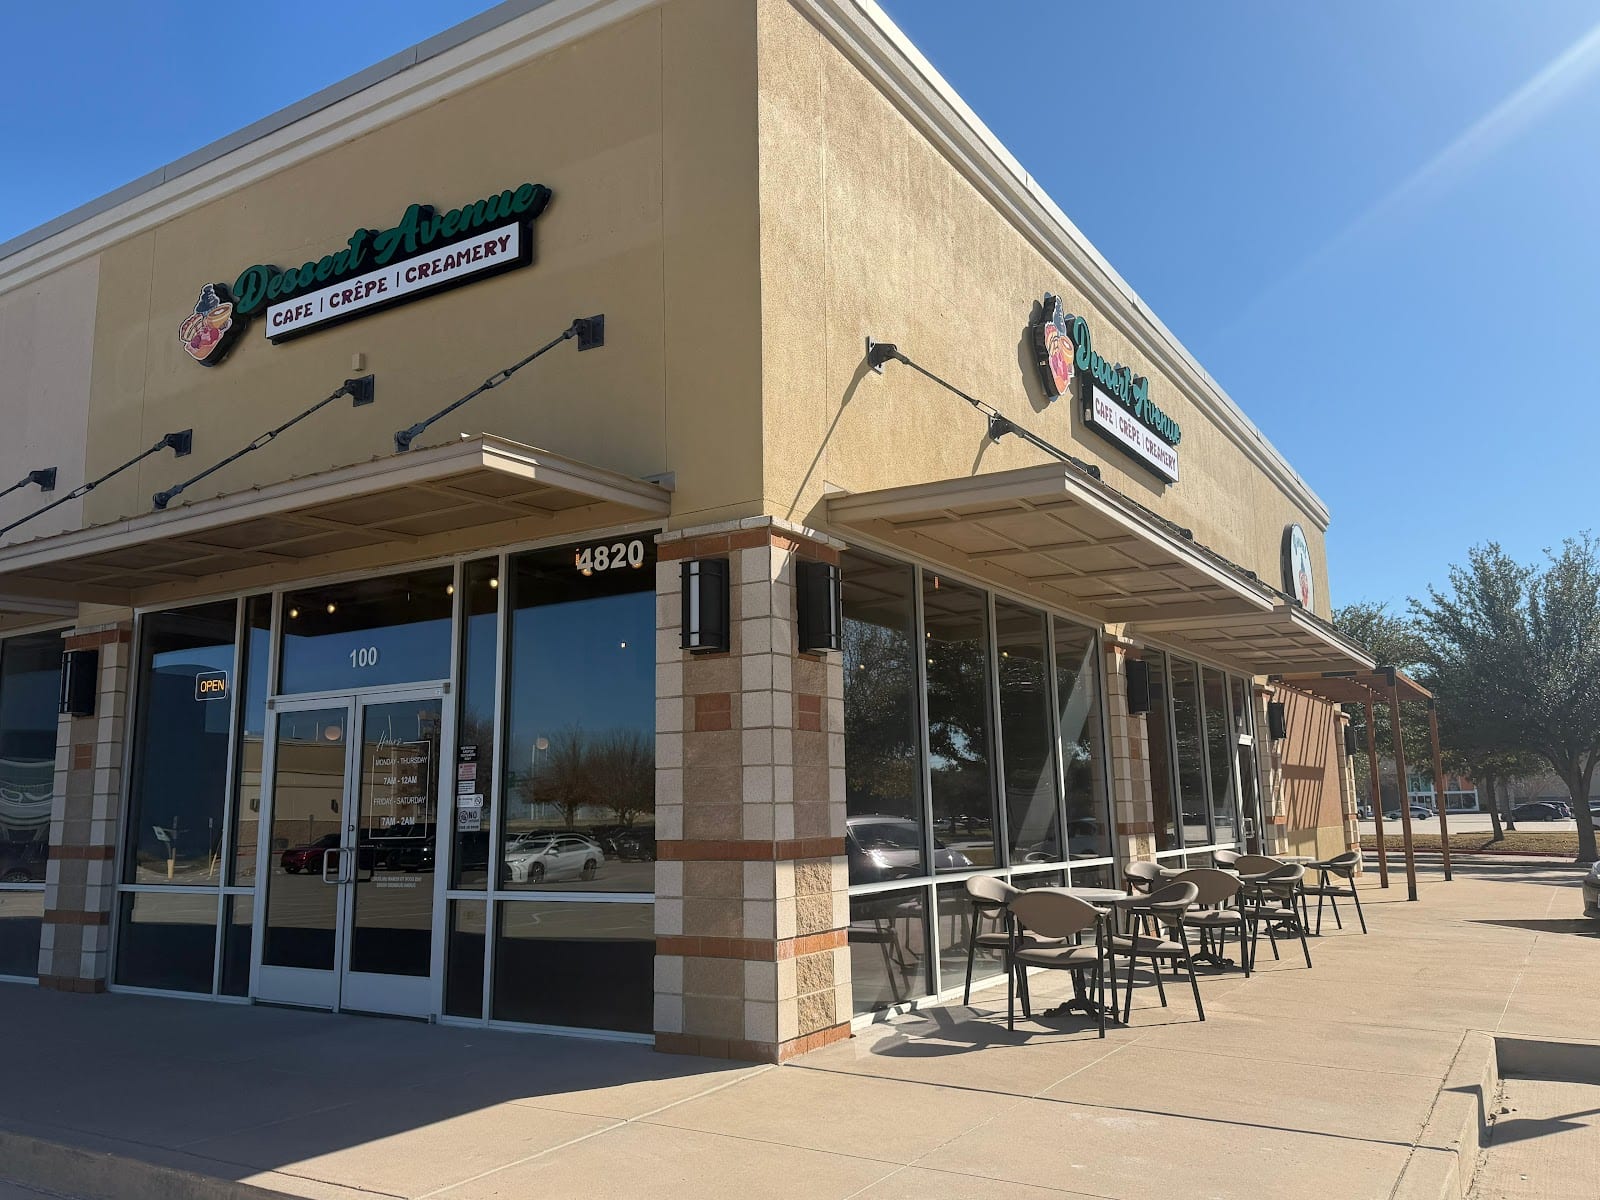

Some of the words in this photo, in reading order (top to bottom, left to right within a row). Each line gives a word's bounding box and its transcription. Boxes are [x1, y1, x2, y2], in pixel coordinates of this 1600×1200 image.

[233, 228, 367, 314] Dessert
[373, 183, 538, 264] Avenue
[272, 302, 313, 327] CAFE
[329, 277, 388, 308] CRÊPE
[405, 234, 511, 283] CREAMERY
[1095, 398, 1114, 426] CAFE
[1145, 436, 1176, 472] CREAMERY
[577, 540, 644, 572] 4820
[350, 646, 377, 668] 100
[200, 679, 225, 692] OPEN
[375, 758, 396, 766] MONDAY
[400, 756, 427, 765] THURSDAY
[383, 776, 397, 785] 7AM
[401, 775, 417, 784] 12AM
[373, 798, 392, 806] FRIDAY
[396, 796, 426, 805] SATURDAY
[381, 817, 396, 826] 7AM
[400, 816, 415, 826] 2AM
